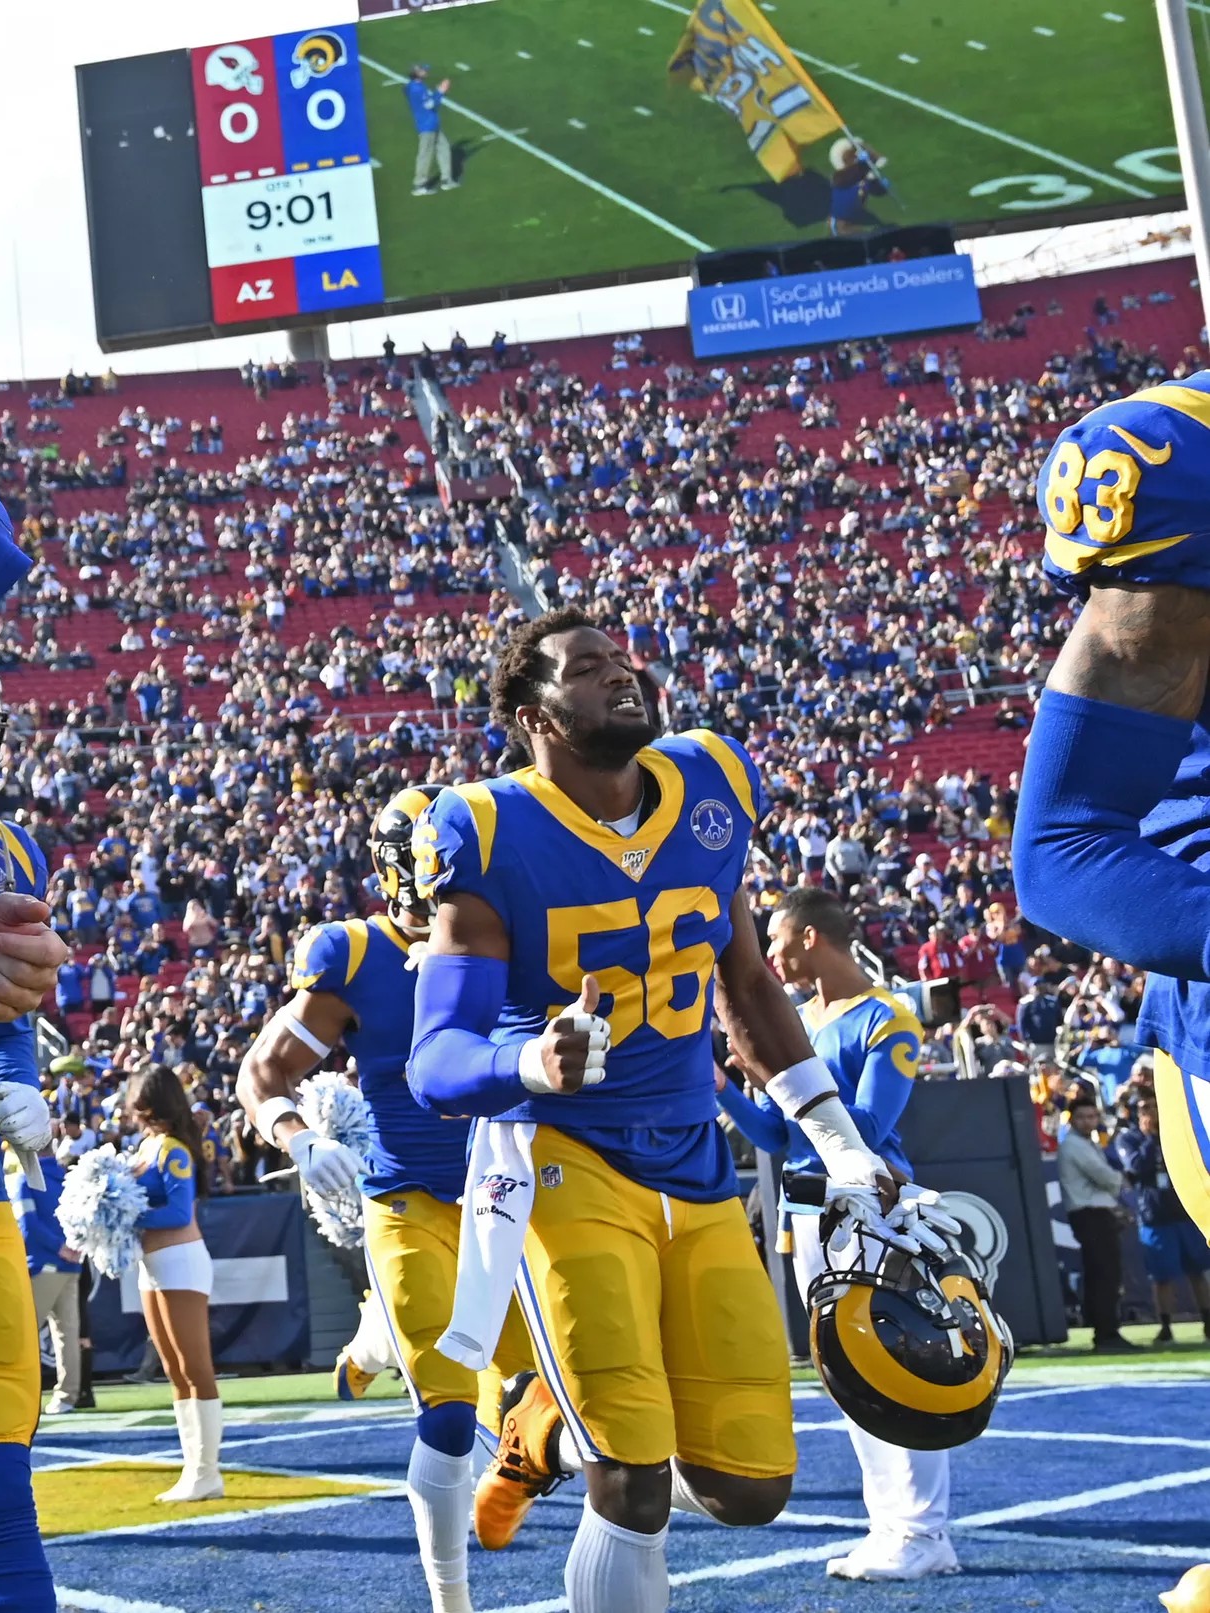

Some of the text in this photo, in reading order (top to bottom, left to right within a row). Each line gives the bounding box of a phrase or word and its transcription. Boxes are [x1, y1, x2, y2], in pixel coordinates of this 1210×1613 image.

[219, 102, 258, 143] 0
[306, 89, 346, 132] 0
[246, 191, 333, 231] 9:01
[236, 278, 275, 303] AZ
[321, 268, 360, 292] LA
[769, 265, 964, 305] SoCal Honda Dealers
[702, 318, 761, 335] HONDA
[772, 302, 841, 326] Helpful
[1045, 441, 1142, 544] 83
[546, 886, 721, 1047] 56
[543, 1174, 559, 1185] NFL
